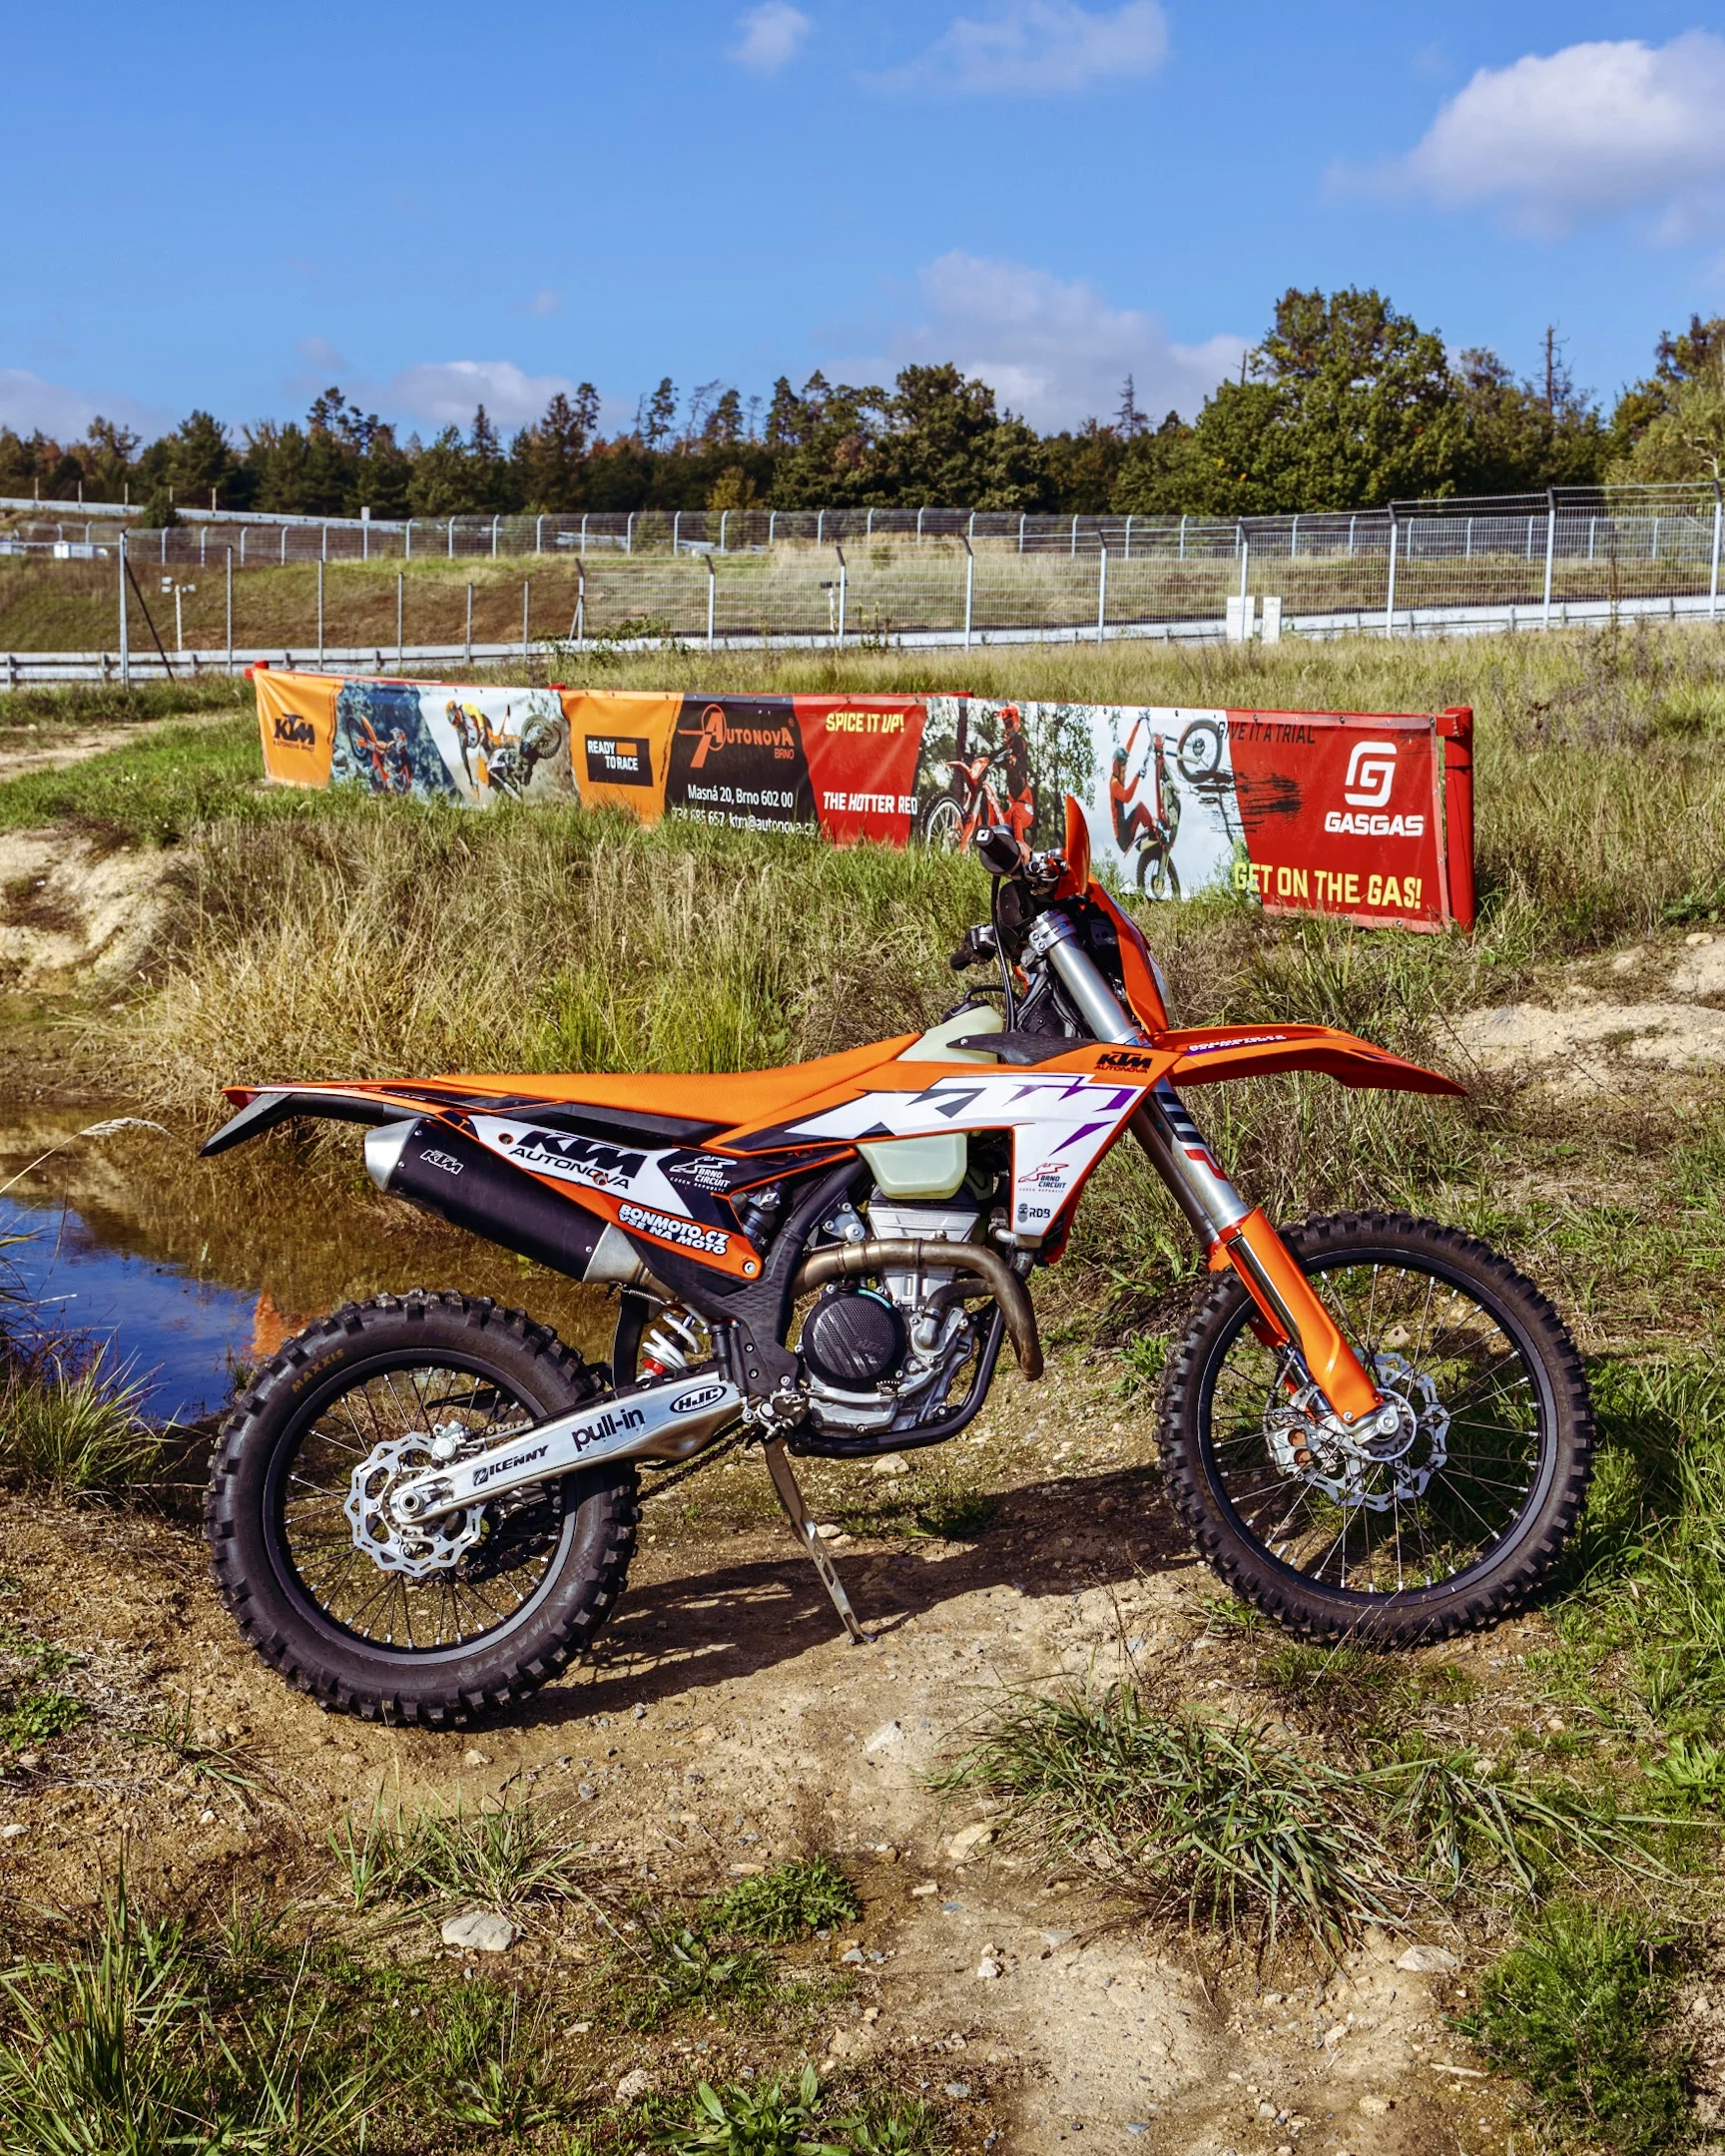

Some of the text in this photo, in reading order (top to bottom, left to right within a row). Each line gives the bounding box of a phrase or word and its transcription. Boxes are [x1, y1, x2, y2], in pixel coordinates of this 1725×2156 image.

[274, 714, 315, 746] KTM
[826, 712, 904, 734] SPICE IT UP!
[1249, 722, 1263, 742] IT
[1263, 724, 1272, 743] A
[1276, 724, 1316, 745] TRIAL
[587, 740, 615, 755] READY
[774, 748, 795, 760] BRNO
[605, 756, 639, 771] TO RACE
[688, 784, 794, 808] Masná 20, Brno 602 00
[823, 792, 918, 814] THE HOTTER RED
[708, 810, 725, 826] 657
[1325, 810, 1425, 836] GASGAS
[1234, 861, 1423, 909] GET ON THE GAS!
[1094, 1065, 1149, 1074] AUTONOVA
[1097, 1051, 1153, 1069] KTM
[419, 1149, 465, 1175] KTM
[516, 1130, 648, 1179] KTM
[694, 1174, 731, 1188] CIRCUIT
[698, 1168, 724, 1178] BRNO
[619, 1204, 730, 1247] BONMOTO.CZ
[649, 1226, 673, 1240] NA
[676, 1236, 727, 1255] MOTO
[291, 1348, 344, 1393] MAXXIS
[679, 1387, 718, 1410] HJC
[571, 1408, 645, 1452] pull-in
[489, 1445, 549, 1475] KENNY
